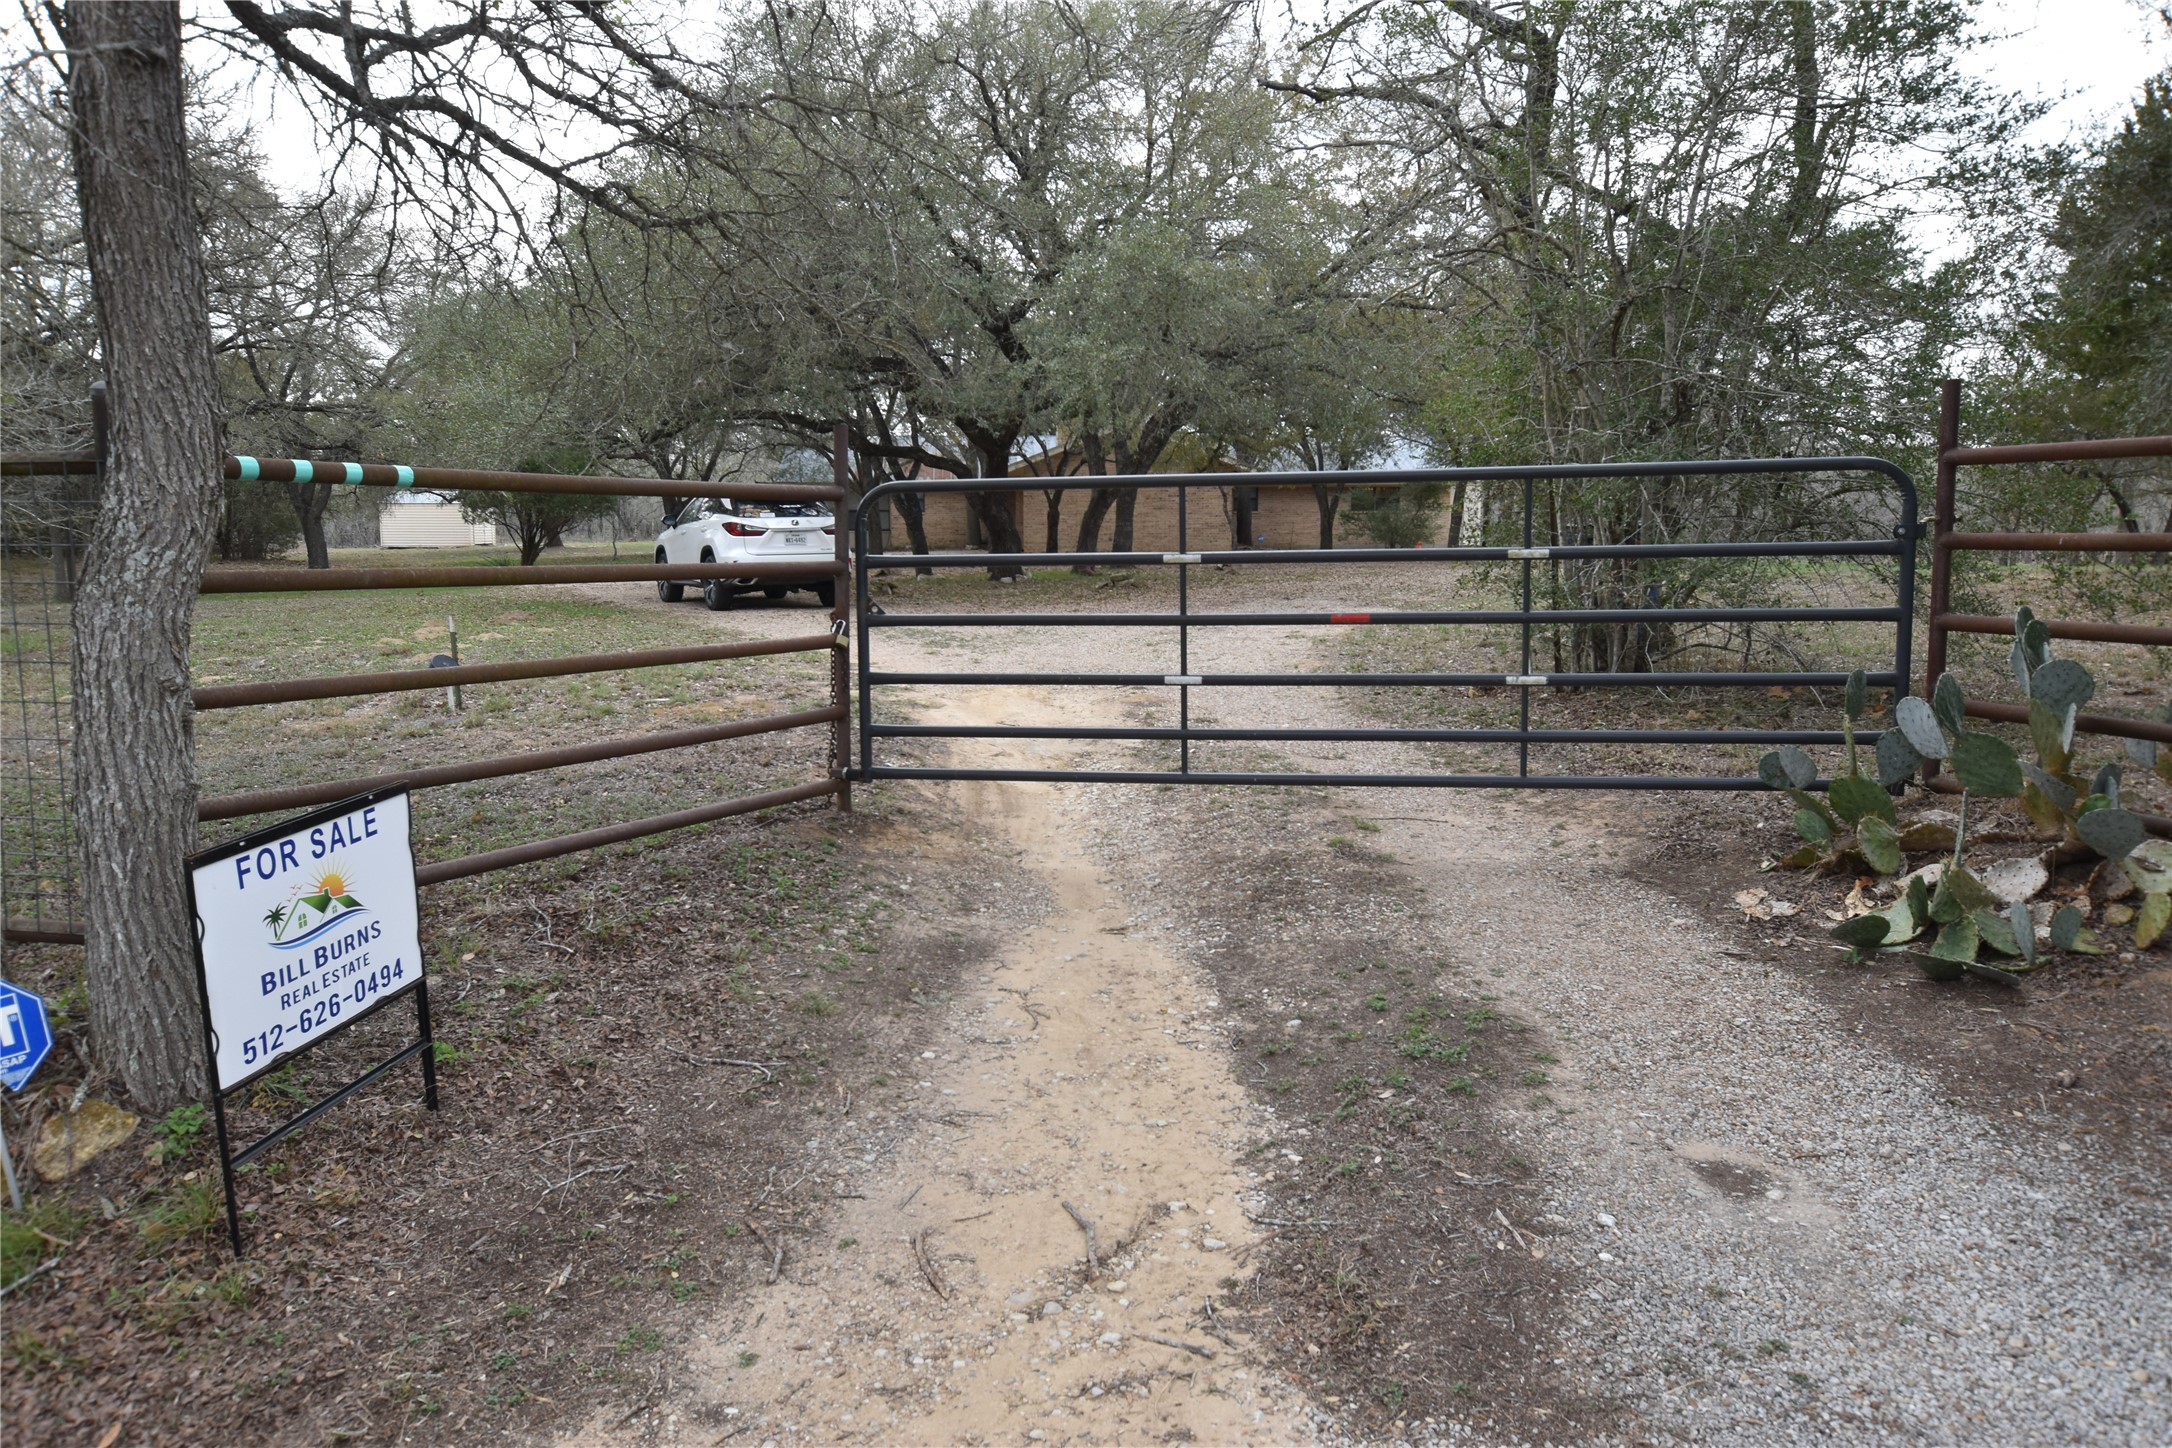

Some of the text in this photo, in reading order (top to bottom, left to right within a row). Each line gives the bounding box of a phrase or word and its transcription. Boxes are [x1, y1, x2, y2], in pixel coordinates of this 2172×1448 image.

[235, 806, 379, 890] FOR SALE
[260, 920, 382, 997] BILL BURNS
[280, 952, 371, 1011] REAL ESTATE
[242, 957, 404, 1065] 512-626-0494
[0, 1054, 27, 1068] SAP
